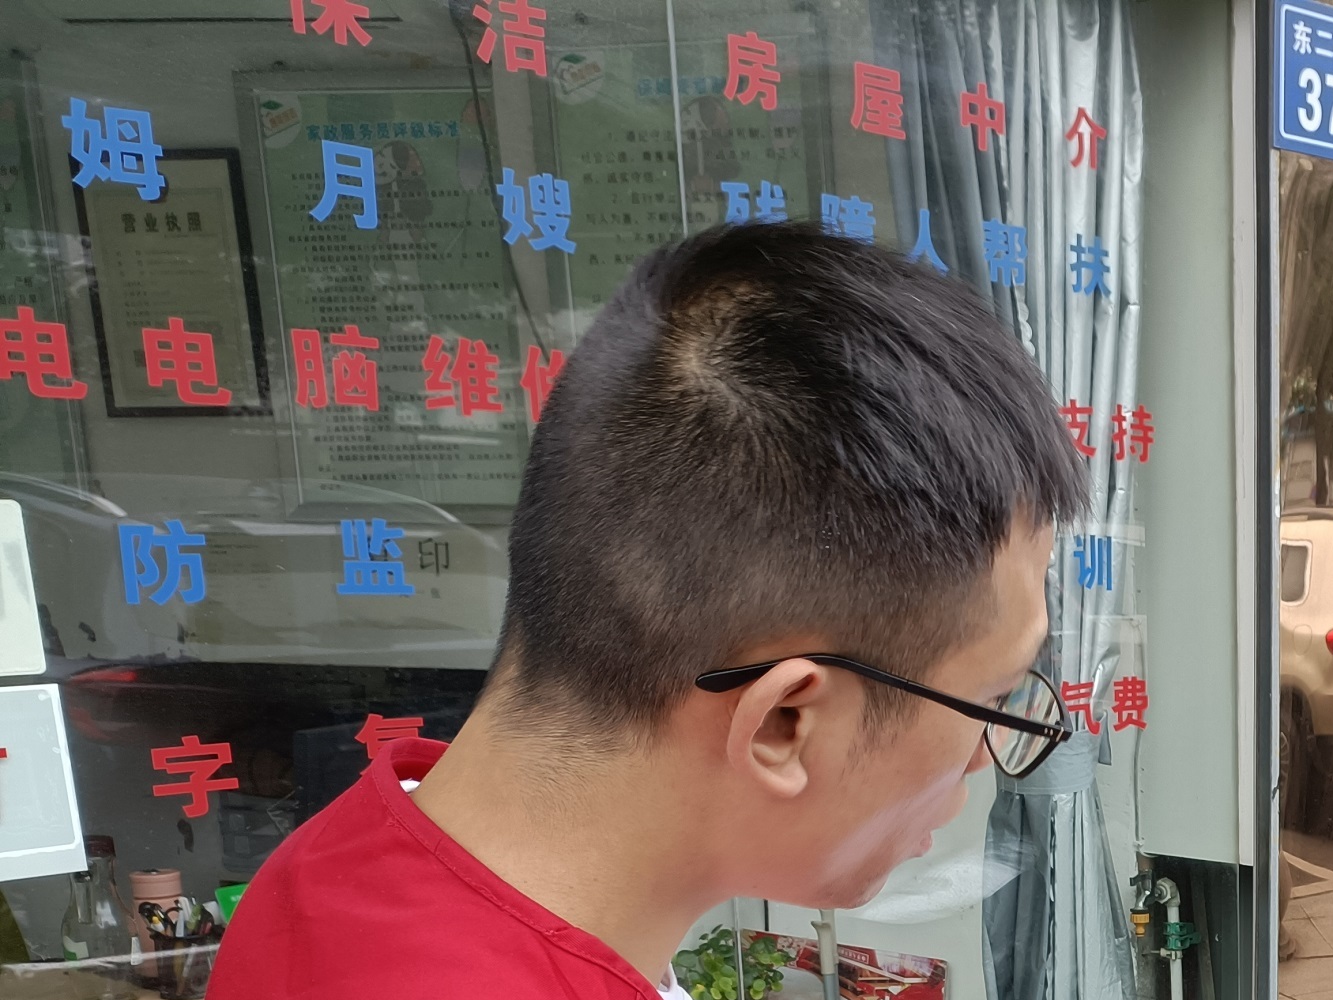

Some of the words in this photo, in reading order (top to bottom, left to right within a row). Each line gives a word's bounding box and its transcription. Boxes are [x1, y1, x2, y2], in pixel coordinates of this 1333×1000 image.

[723, 32, 1107, 169] 房屋中介
[121, 212, 203, 233] 营业执照
[1058, 399, 1155, 463] 支持
[1073, 535, 1113, 590] 训
[1060, 676, 1149, 736] 气费
